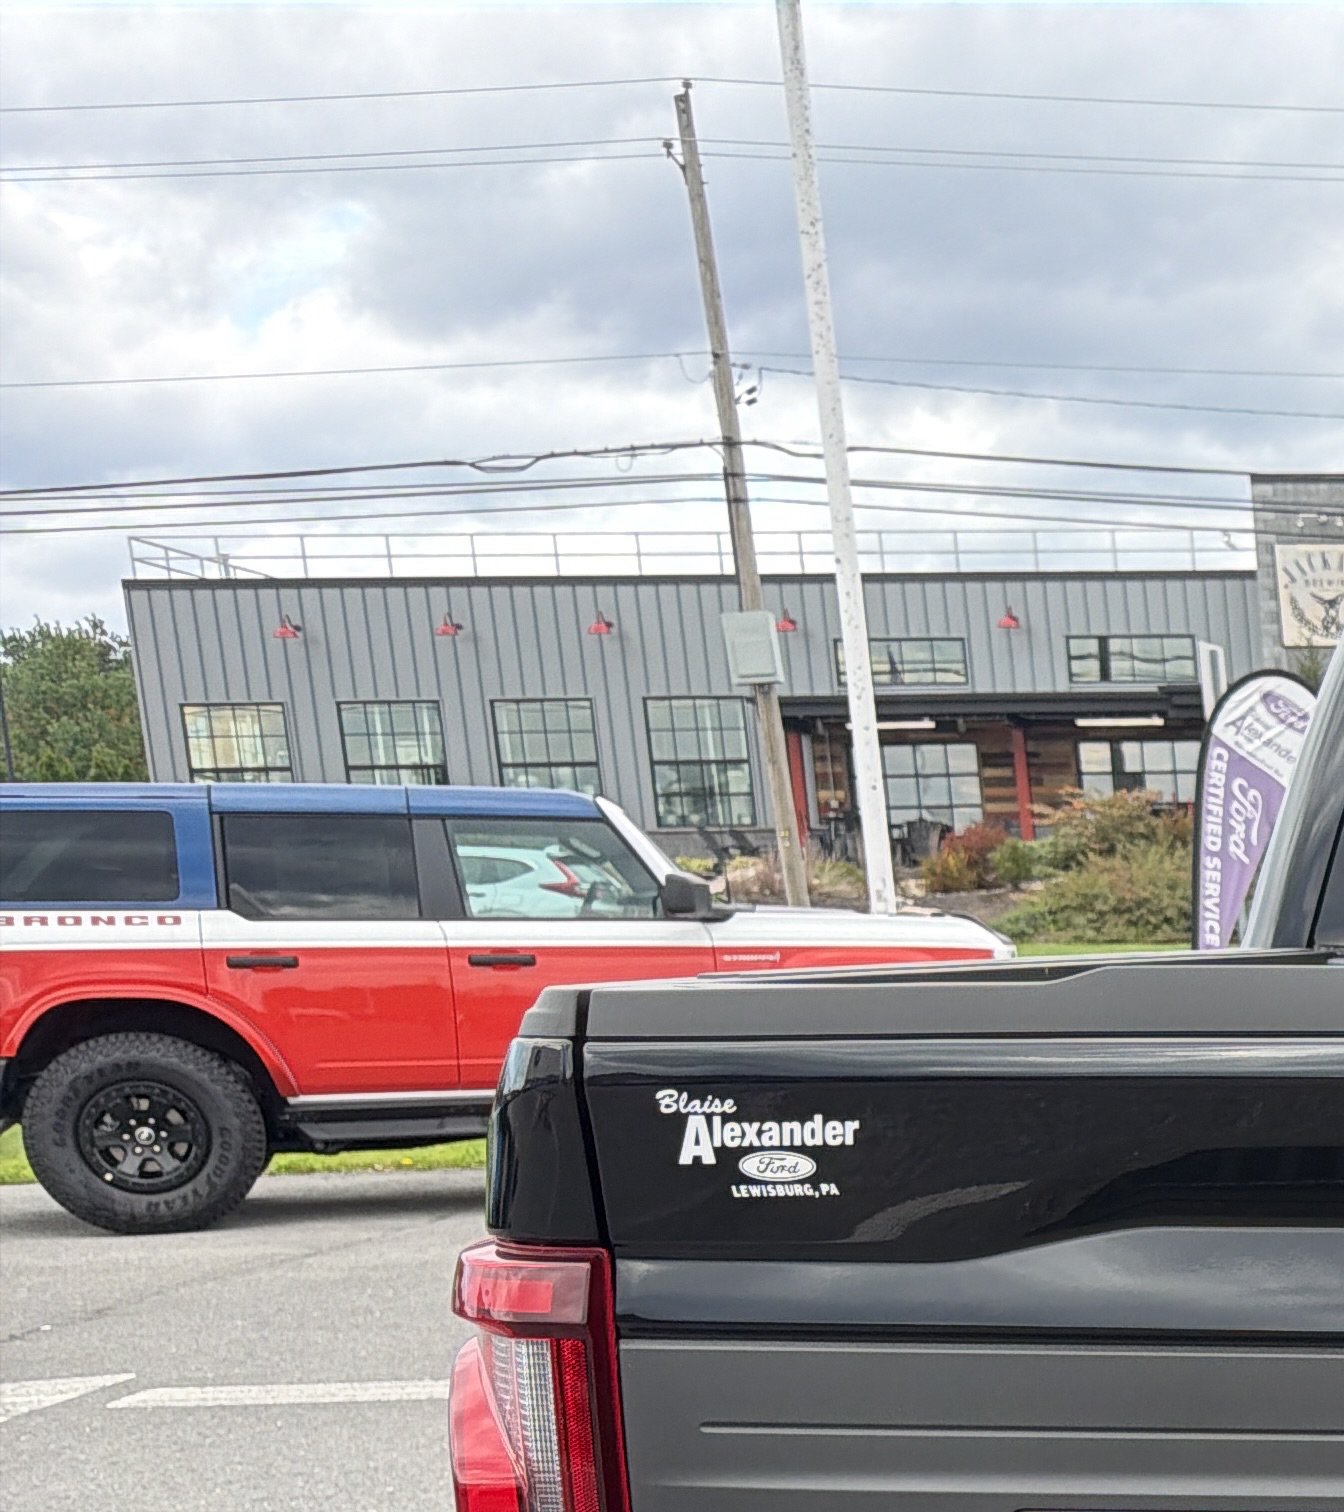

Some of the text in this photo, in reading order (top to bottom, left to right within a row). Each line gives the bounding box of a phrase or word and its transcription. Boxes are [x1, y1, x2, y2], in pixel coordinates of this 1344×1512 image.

[1224, 709, 1298, 766] Alexande
[1200, 747, 1229, 947] CERTIFIED SERVICE
[1229, 776, 1263, 866] Ford
[655, 1089, 737, 1114] Blaise
[678, 1114, 860, 1165] Alexander
[756, 1156, 801, 1176] Ford
